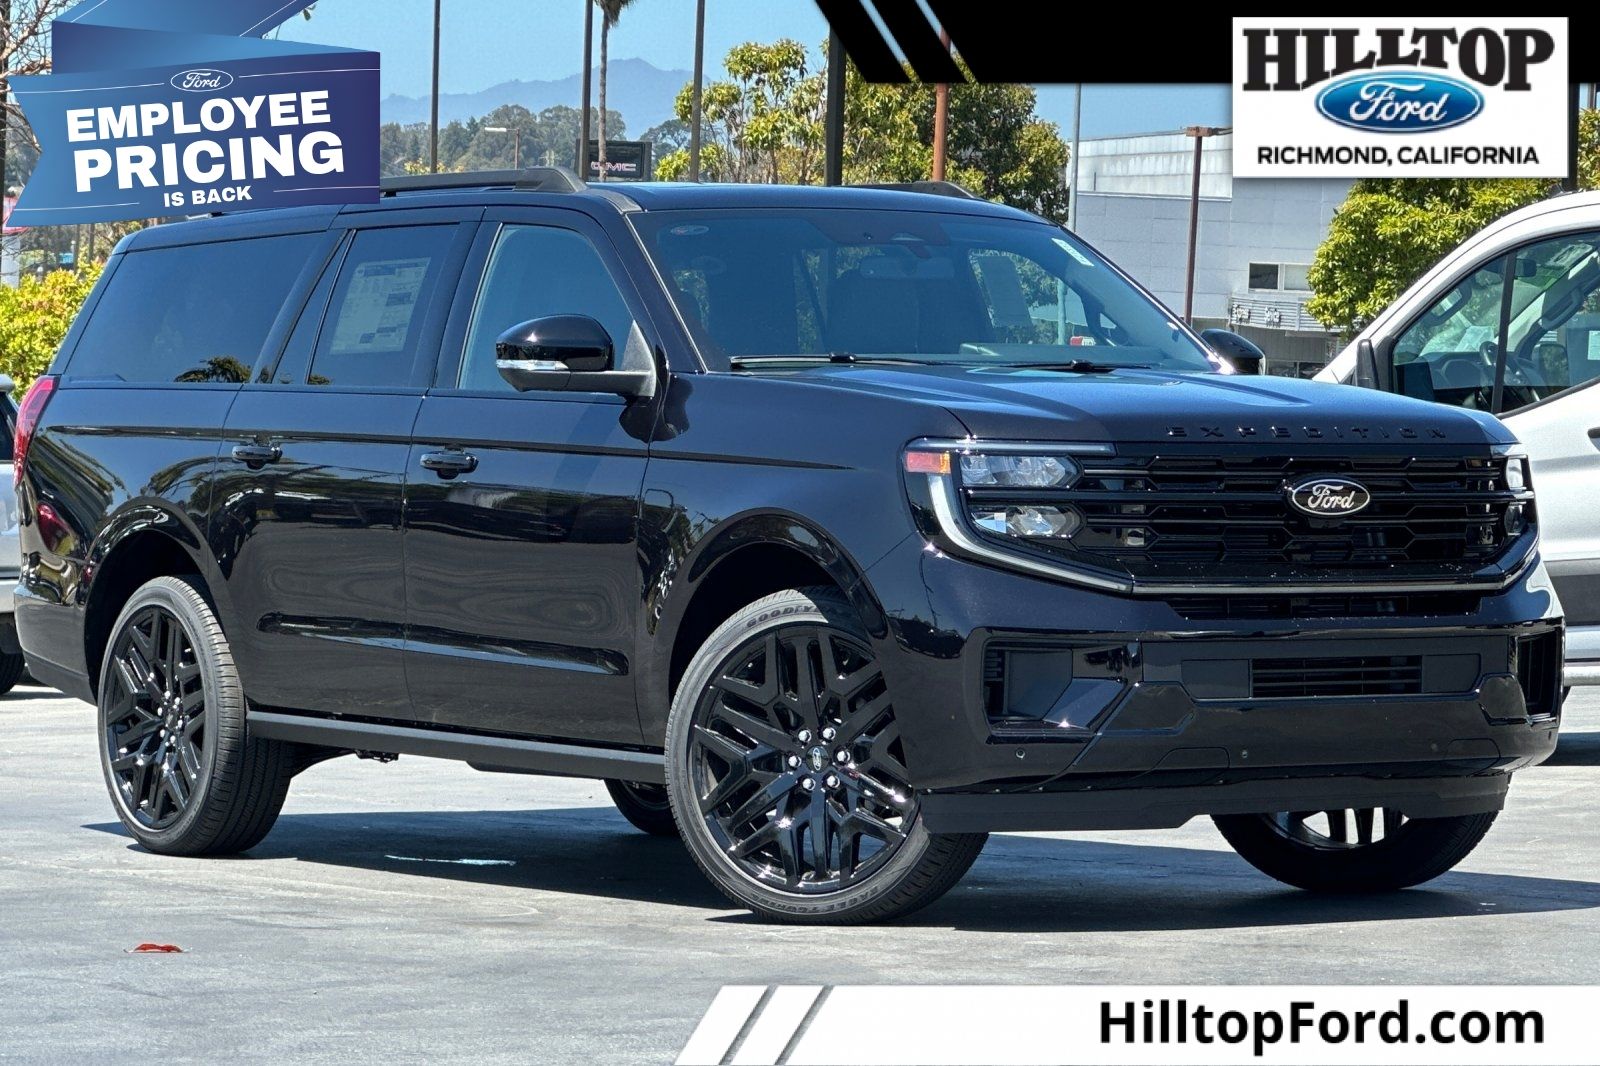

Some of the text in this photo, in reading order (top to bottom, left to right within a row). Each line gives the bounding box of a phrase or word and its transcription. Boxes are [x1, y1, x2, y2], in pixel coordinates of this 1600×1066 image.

[590, 161, 637, 171] GMC
[1165, 425, 1447, 440] EXPEDITION
[1307, 483, 1356, 509] Ford
